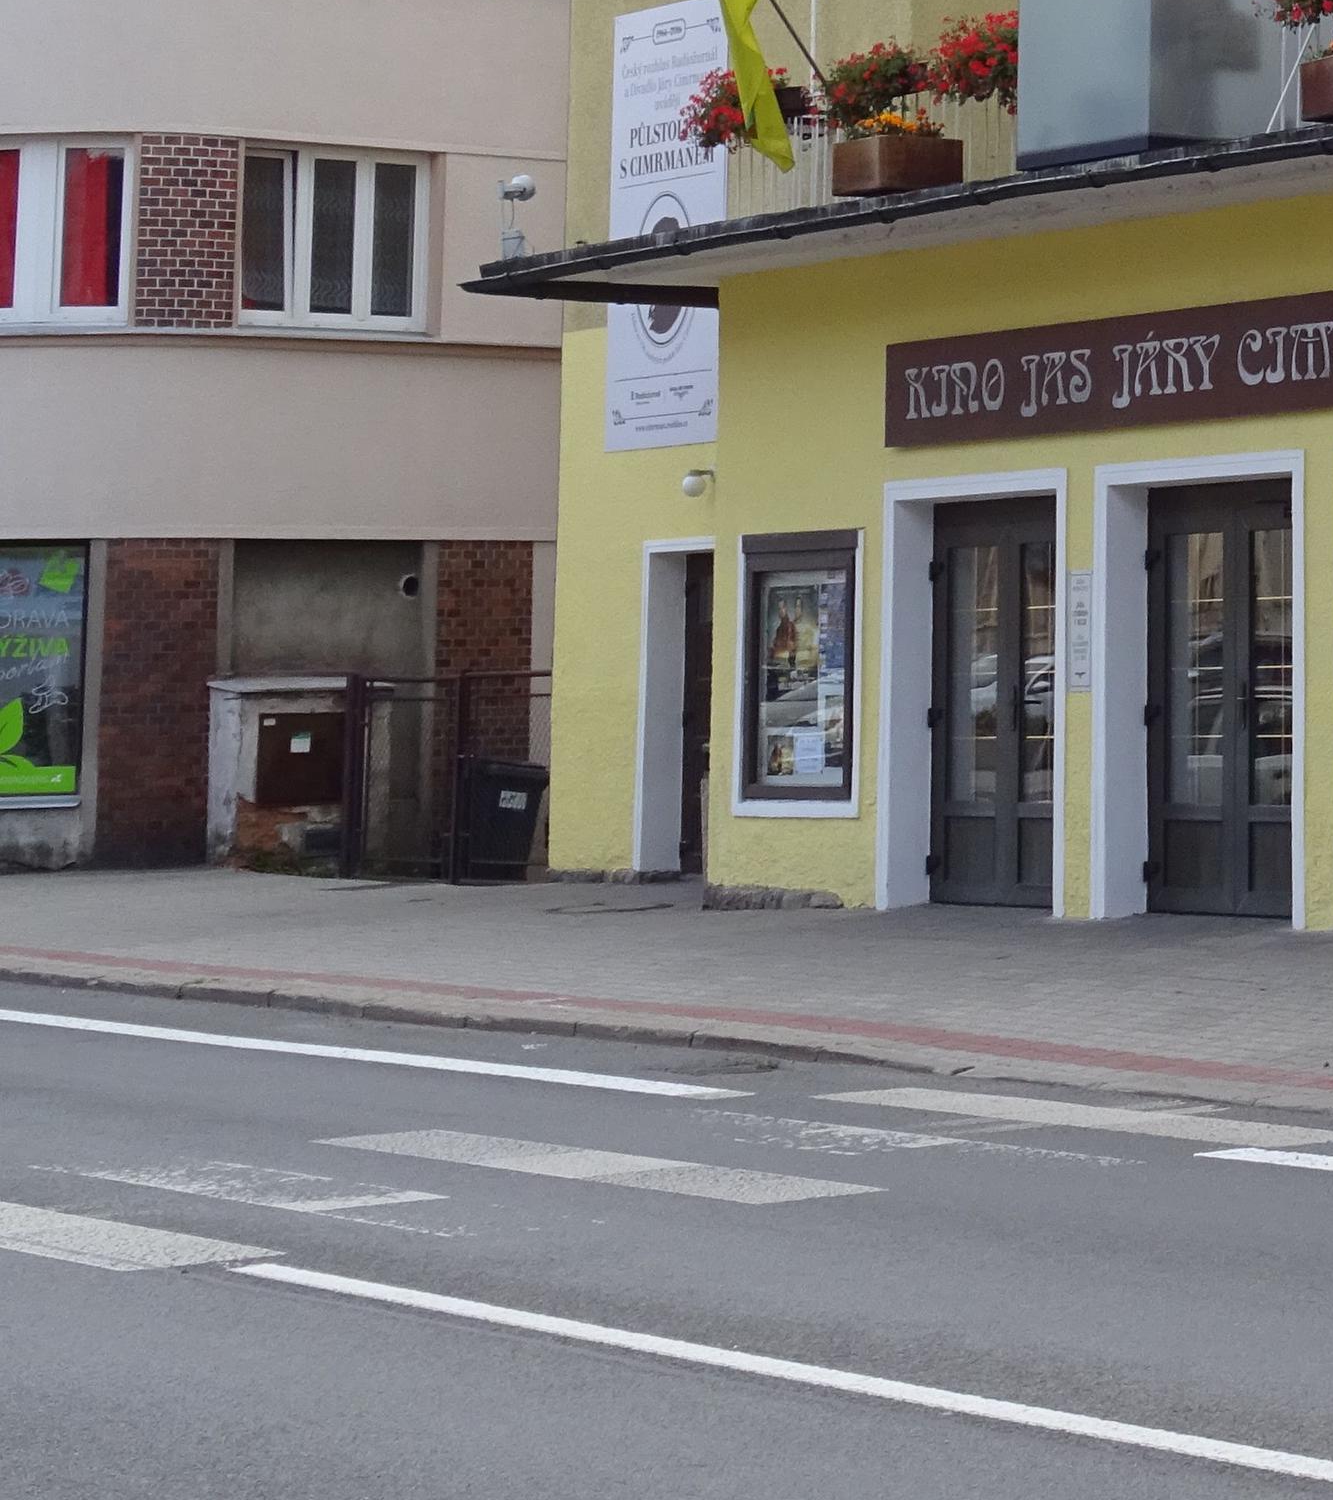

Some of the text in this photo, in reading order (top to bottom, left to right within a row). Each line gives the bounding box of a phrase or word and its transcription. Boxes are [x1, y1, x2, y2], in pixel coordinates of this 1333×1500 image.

[619, 158, 628, 180] S
[903, 357, 1005, 420] KINO
[1018, 348, 1093, 418] JAS
[1111, 330, 1220, 409] JÁRY
